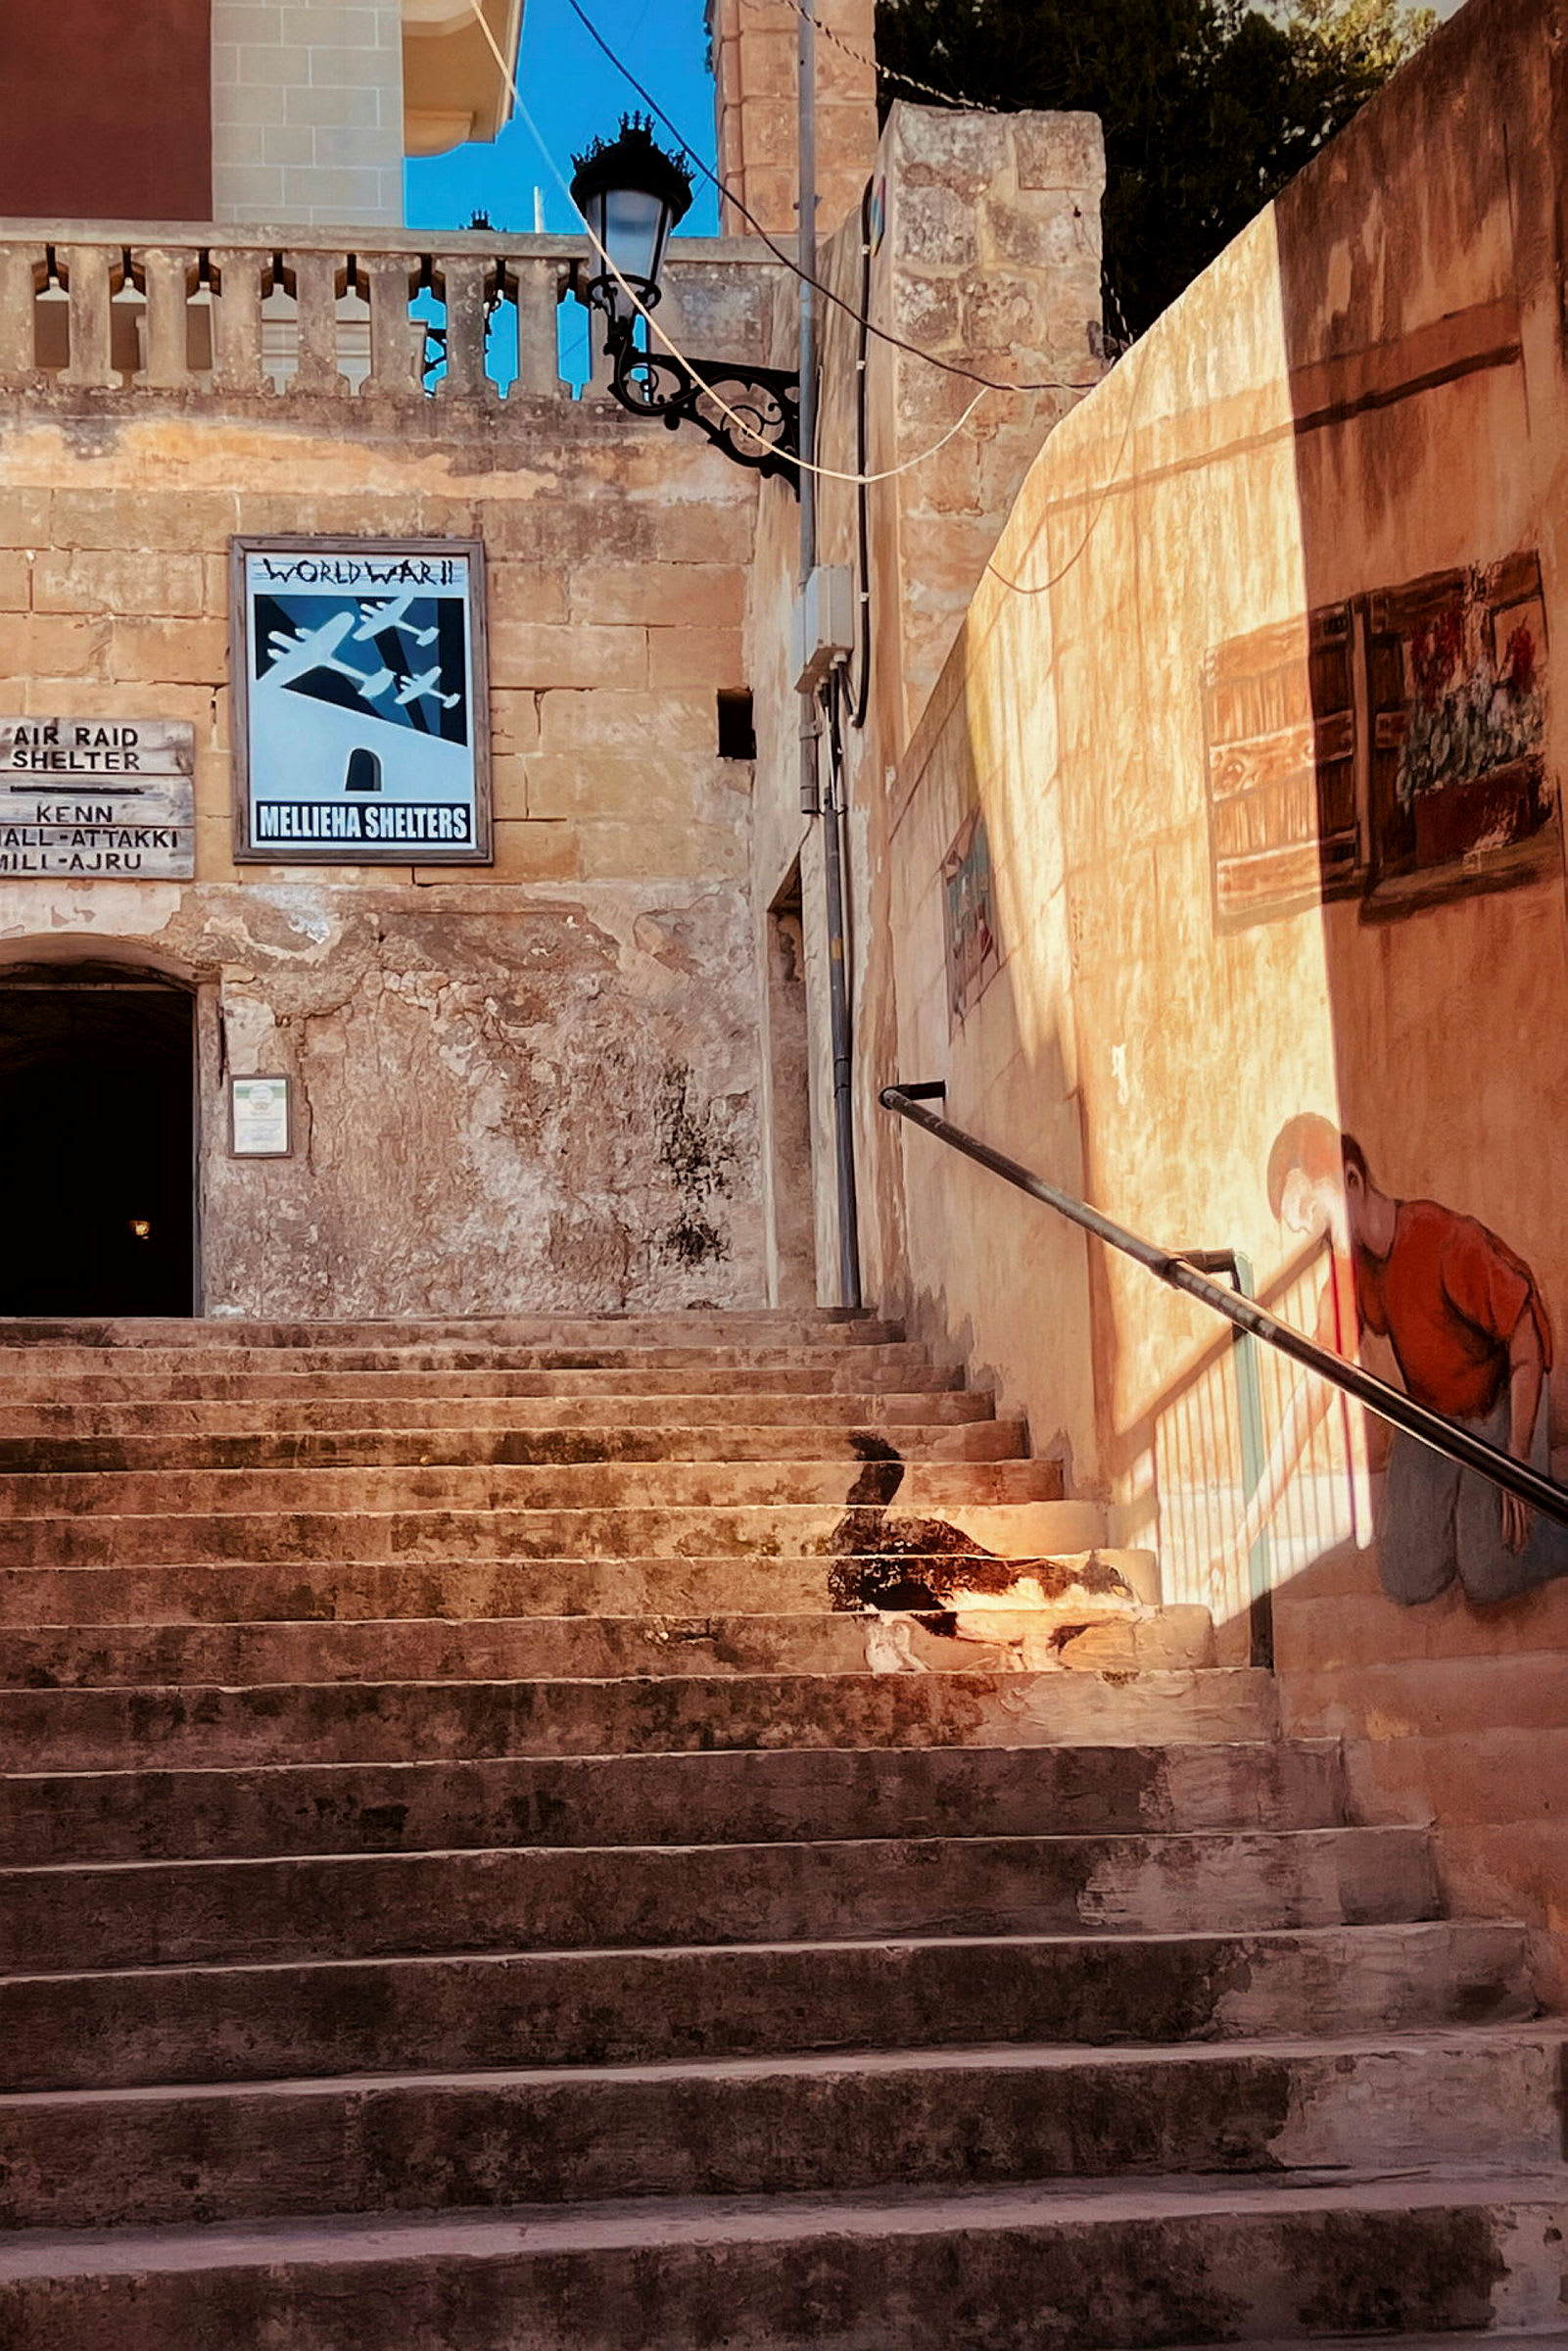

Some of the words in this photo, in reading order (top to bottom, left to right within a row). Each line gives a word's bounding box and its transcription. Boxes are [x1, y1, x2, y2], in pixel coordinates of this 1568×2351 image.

[262, 557, 361, 585] WORLD
[364, 559, 437, 586] WAR
[14, 726, 59, 745] AIR
[75, 727, 139, 747] RAID
[12, 750, 140, 771] SHELTER
[36, 805, 113, 823] KENN
[260, 805, 361, 838] MELLIEHA
[364, 806, 467, 840] SHELTERS
